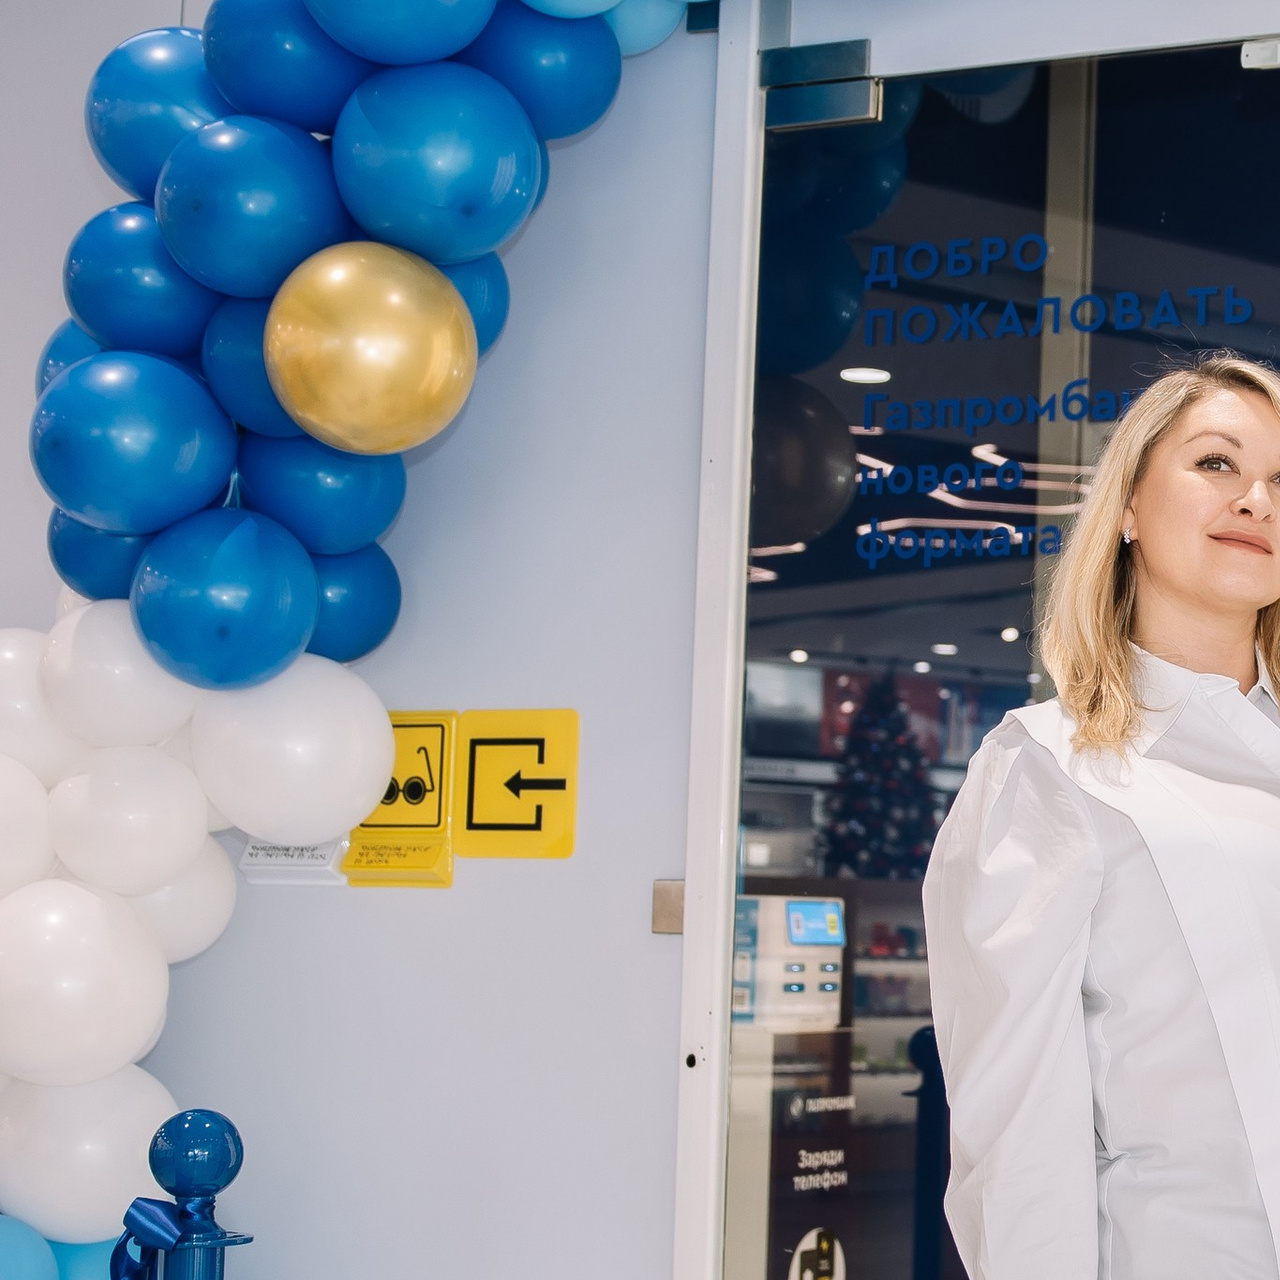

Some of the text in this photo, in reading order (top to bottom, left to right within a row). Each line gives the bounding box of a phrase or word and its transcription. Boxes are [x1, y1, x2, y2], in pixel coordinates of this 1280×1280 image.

[864, 232, 1049, 290] ДОБРО
[863, 285, 1254, 347] ПОЖАЛОВАТЬ
[862, 378, 1144, 437] Газпромба
[860, 459, 1024, 496] нового
[856, 517, 1062, 570] формата
